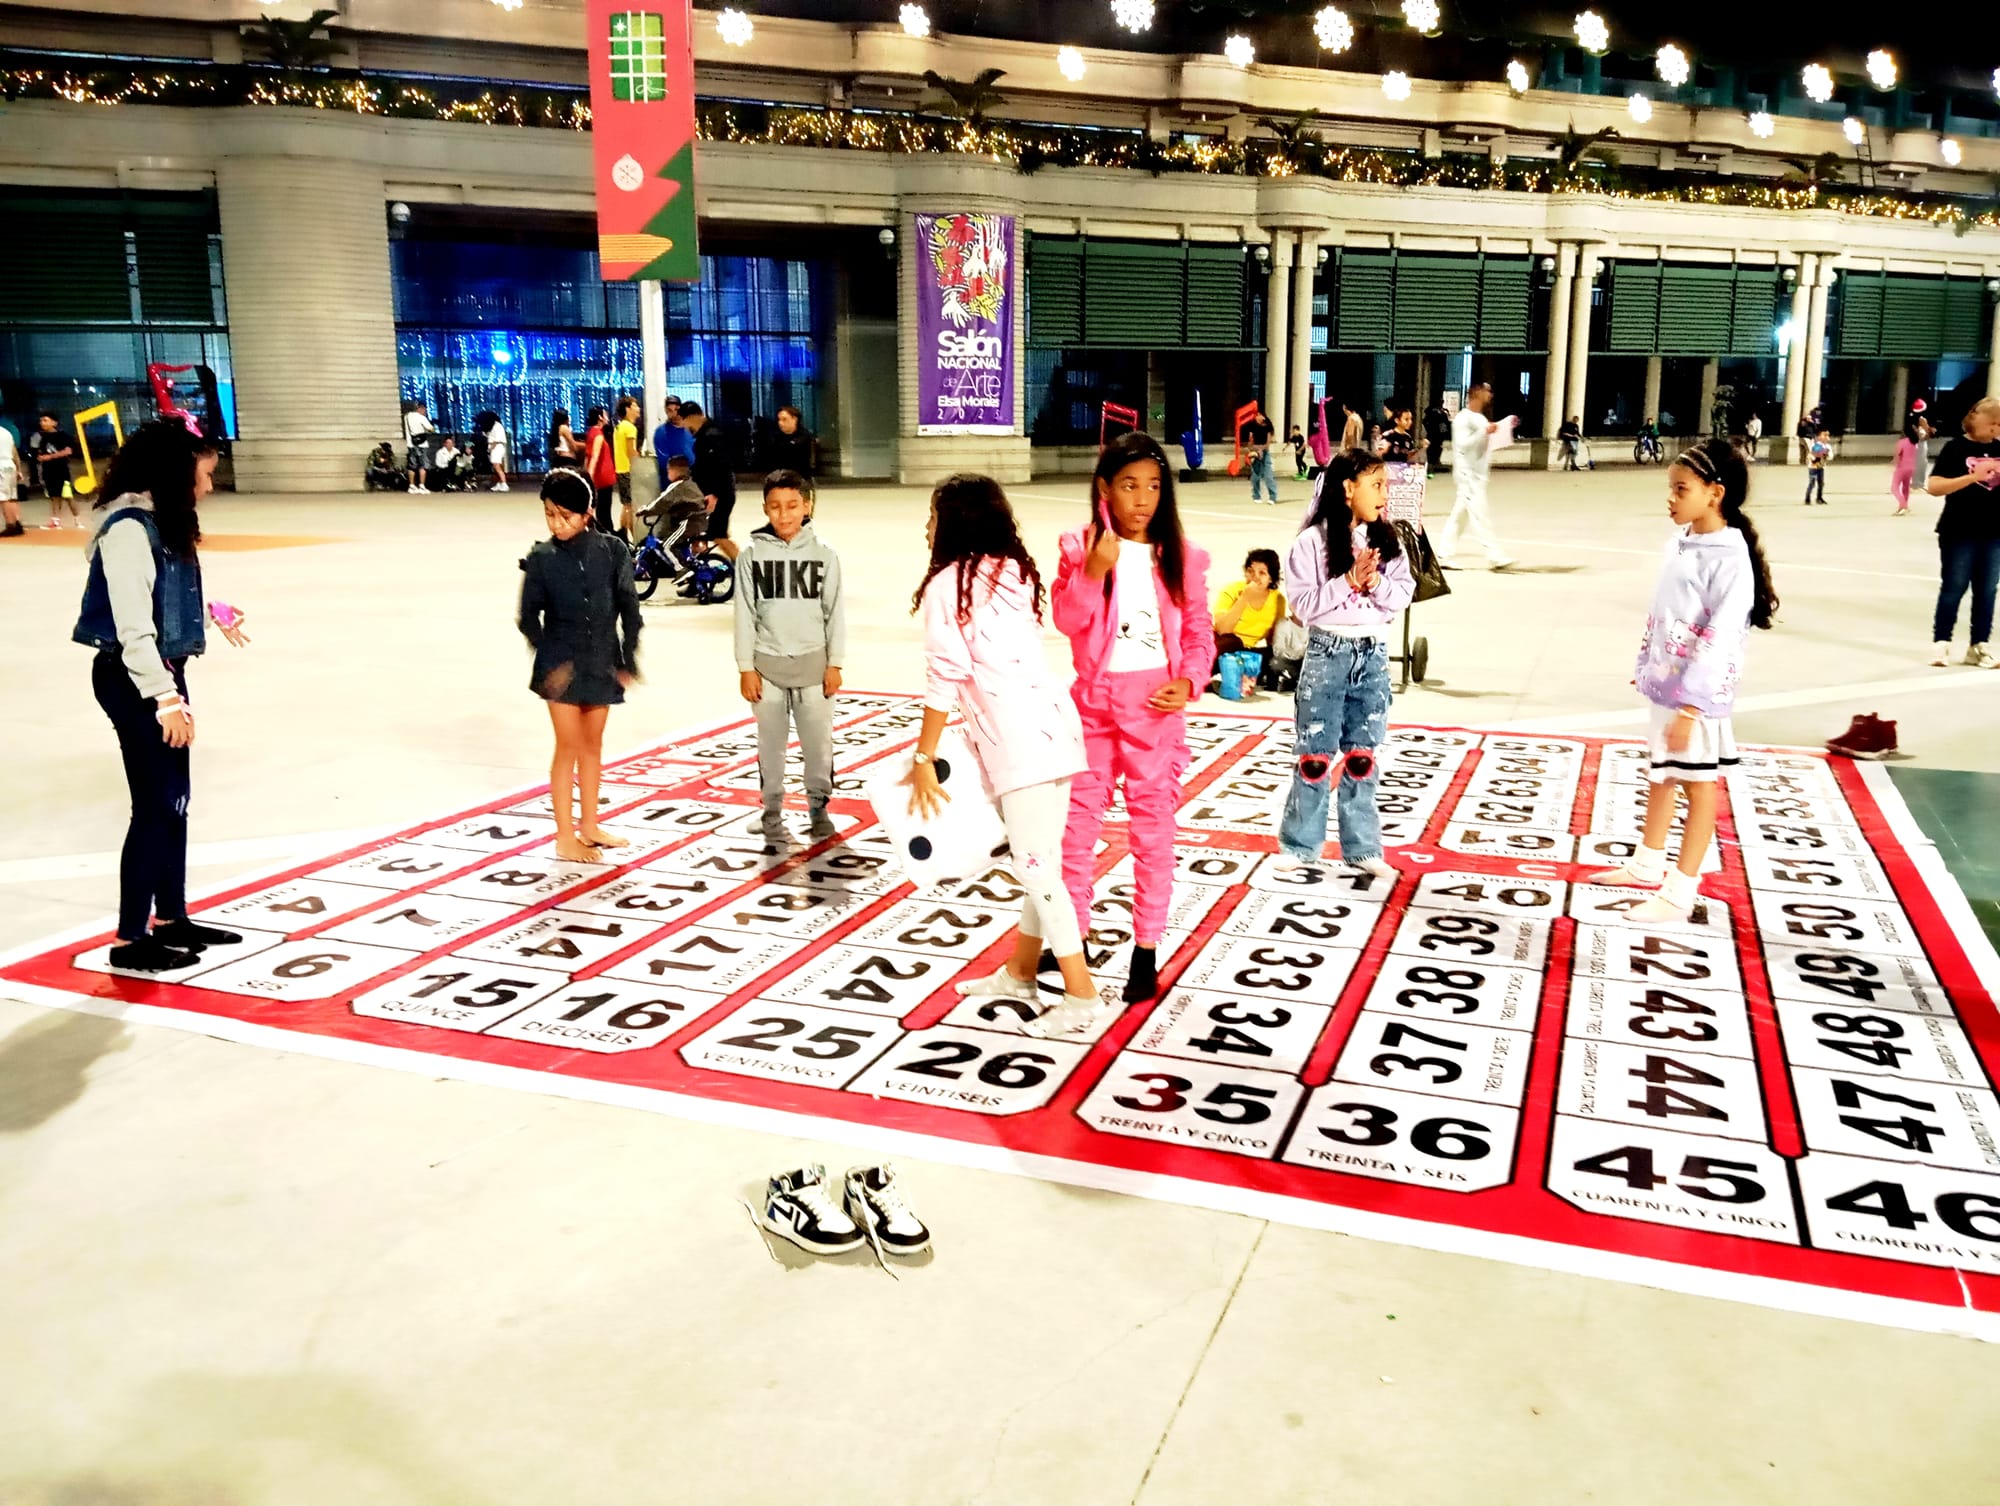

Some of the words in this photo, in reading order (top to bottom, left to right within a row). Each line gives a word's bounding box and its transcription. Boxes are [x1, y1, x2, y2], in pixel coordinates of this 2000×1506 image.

[937, 328, 1003, 358] Salón
[937, 357, 1002, 370] NACIONAL
[937, 395, 961, 408] Elsa
[962, 395, 1000, 408] Morales
[943, 376, 957, 388] de
[954, 367, 1002, 399] Arte
[751, 560, 825, 599] NIKE
[1394, 750, 1447, 768] 67
[1495, 757, 1549, 775] 64
[1214, 781, 1280, 799] 72
[1485, 778, 1543, 798] 63
[642, 806, 727, 826] 10
[1475, 801, 1534, 823] 62
[1752, 797, 1815, 819] 53
[466, 826, 531, 840] 2
[1758, 823, 1828, 849] 52
[376, 857, 445, 874] 3
[480, 870, 549, 887] 8
[1766, 856, 1843, 887] 51
[264, 896, 328, 915] 4
[614, 880, 710, 912] 13
[733, 892, 828, 926] 18
[1430, 883, 1553, 908] 40
[371, 908, 442, 927] 7
[897, 908, 993, 948] 23
[1268, 901, 1352, 939] 32
[1418, 915, 1501, 956] 39
[1781, 903, 1865, 941] 50
[515, 922, 624, 960] 14
[647, 935, 745, 976] 17
[1629, 935, 1712, 981] 42
[271, 952, 352, 979] 6
[818, 955, 932, 1004] 24
[1233, 947, 1325, 991] 33
[1794, 953, 1887, 1002] 49
[407, 971, 541, 1009] 15
[1395, 965, 1487, 1015] 38
[380, 999, 478, 1022] QUINCE
[556, 992, 687, 1031] 16
[1628, 989, 1720, 1042] 43
[520, 1020, 639, 1046] DIECISEIS
[715, 1016, 877, 1061] 25
[1186, 1001, 1293, 1058] 34
[1811, 1012, 1914, 1070] 48
[702, 1049, 838, 1080] VEINTICINCO
[893, 1040, 1057, 1090] 26
[1369, 1021, 1469, 1085] 37
[883, 1078, 1005, 1109] VEINTISEIS
[1111, 1072, 1279, 1125] 35
[1627, 1054, 1730, 1123] 44
[1098, 1114, 1182, 1136] TREINTA
[1184, 1127, 1200, 1140] Y
[1202, 1130, 1269, 1151] CINCO
[1316, 1101, 1493, 1162] 36
[1829, 1078, 1947, 1154] 47
[1304, 1146, 1397, 1173] TREINTA
[1402, 1163, 1418, 1176] Y
[1424, 1168, 1469, 1184] SEIS
[1572, 1144, 1768, 1205] 45
[1571, 1188, 1687, 1219] CUARENTA
[1695, 1206, 1709, 1220] Y
[1715, 1211, 1789, 1232] CINCO
[1825, 1179, 2000, 1243] 46
[1834, 1230, 1965, 1258] CUARENTA
[1967, 1249, 1983, 1260] Y
